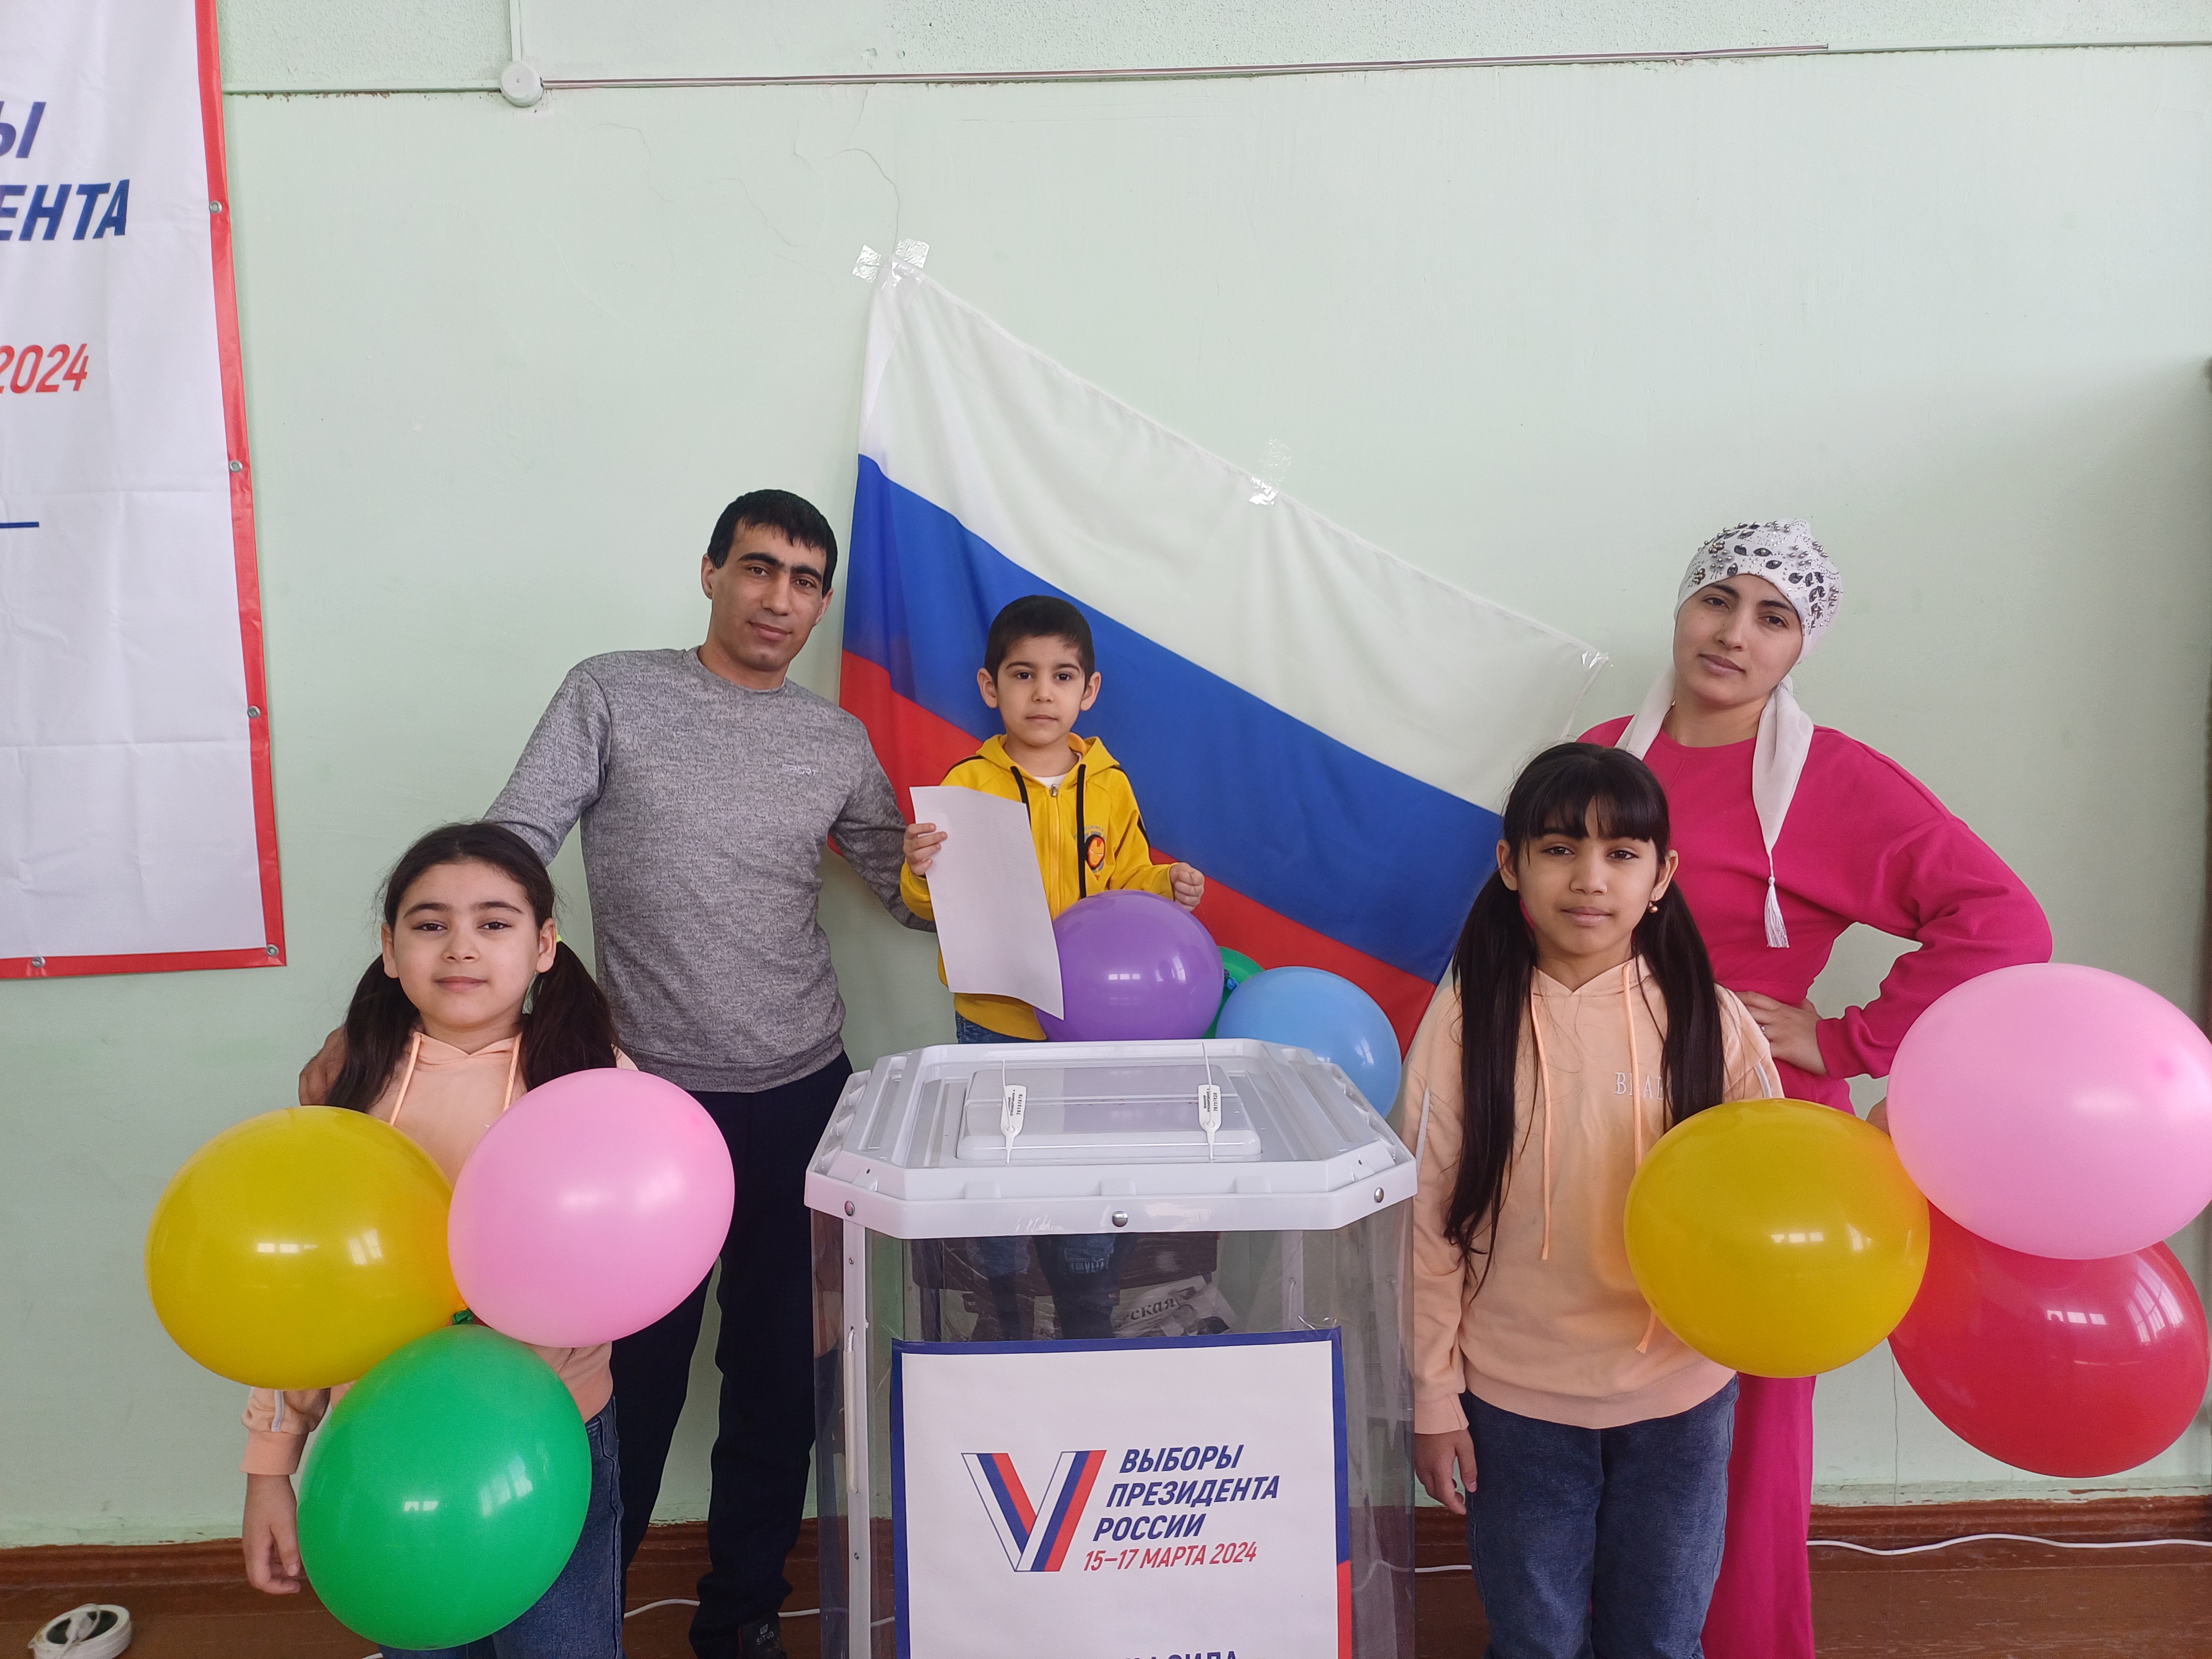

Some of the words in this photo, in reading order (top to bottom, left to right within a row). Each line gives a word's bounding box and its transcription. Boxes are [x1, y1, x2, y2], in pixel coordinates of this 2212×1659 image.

[0, 179, 130, 241] ЕНТА
[0, 343, 88, 393] 2024
[1126, 1297, 1176, 1321] ская
[1119, 1444, 1244, 1473] ВЫБОРЫ
[1106, 1475, 1280, 1507] ПРЕЗИДЕНТА
[1092, 1513, 1207, 1542] РОССИИ
[1139, 1545, 1207, 1569] МАРТА
[1209, 1541, 1258, 1564] 2024
